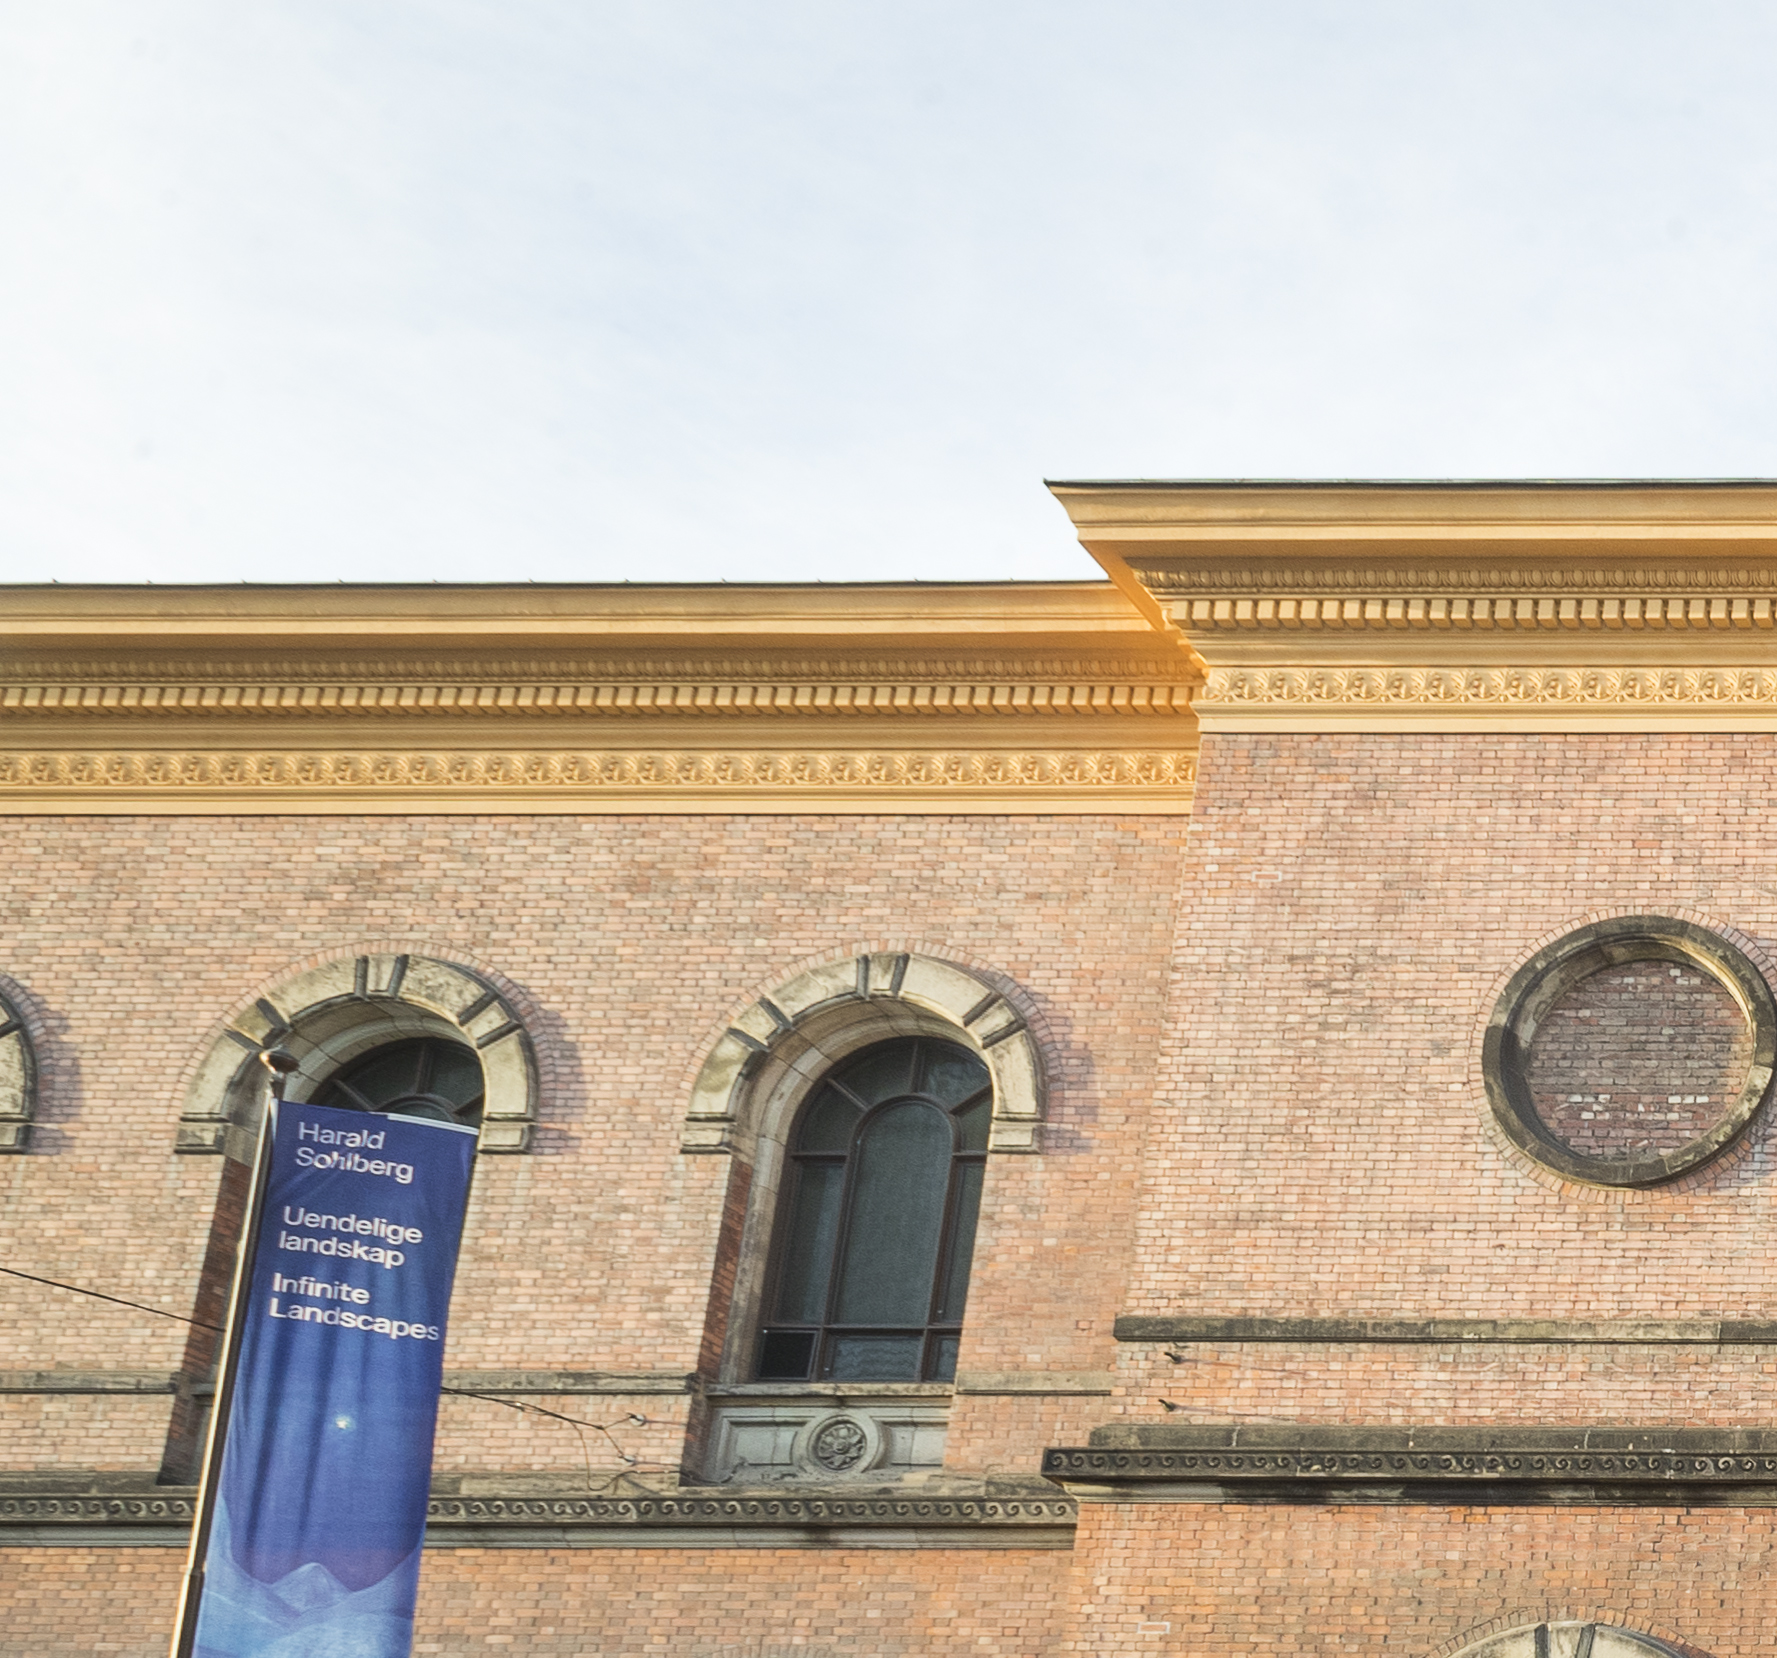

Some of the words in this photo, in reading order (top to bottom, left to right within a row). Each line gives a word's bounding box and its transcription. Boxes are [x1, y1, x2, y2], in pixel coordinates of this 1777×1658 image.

[298, 1121, 386, 1150] Harald
[295, 1147, 414, 1185] Sohlberg
[283, 1205, 423, 1245] Uendelige
[278, 1231, 405, 1269] landskap
[272, 1273, 370, 1305] Infinite
[269, 1298, 441, 1341] Landscapes
